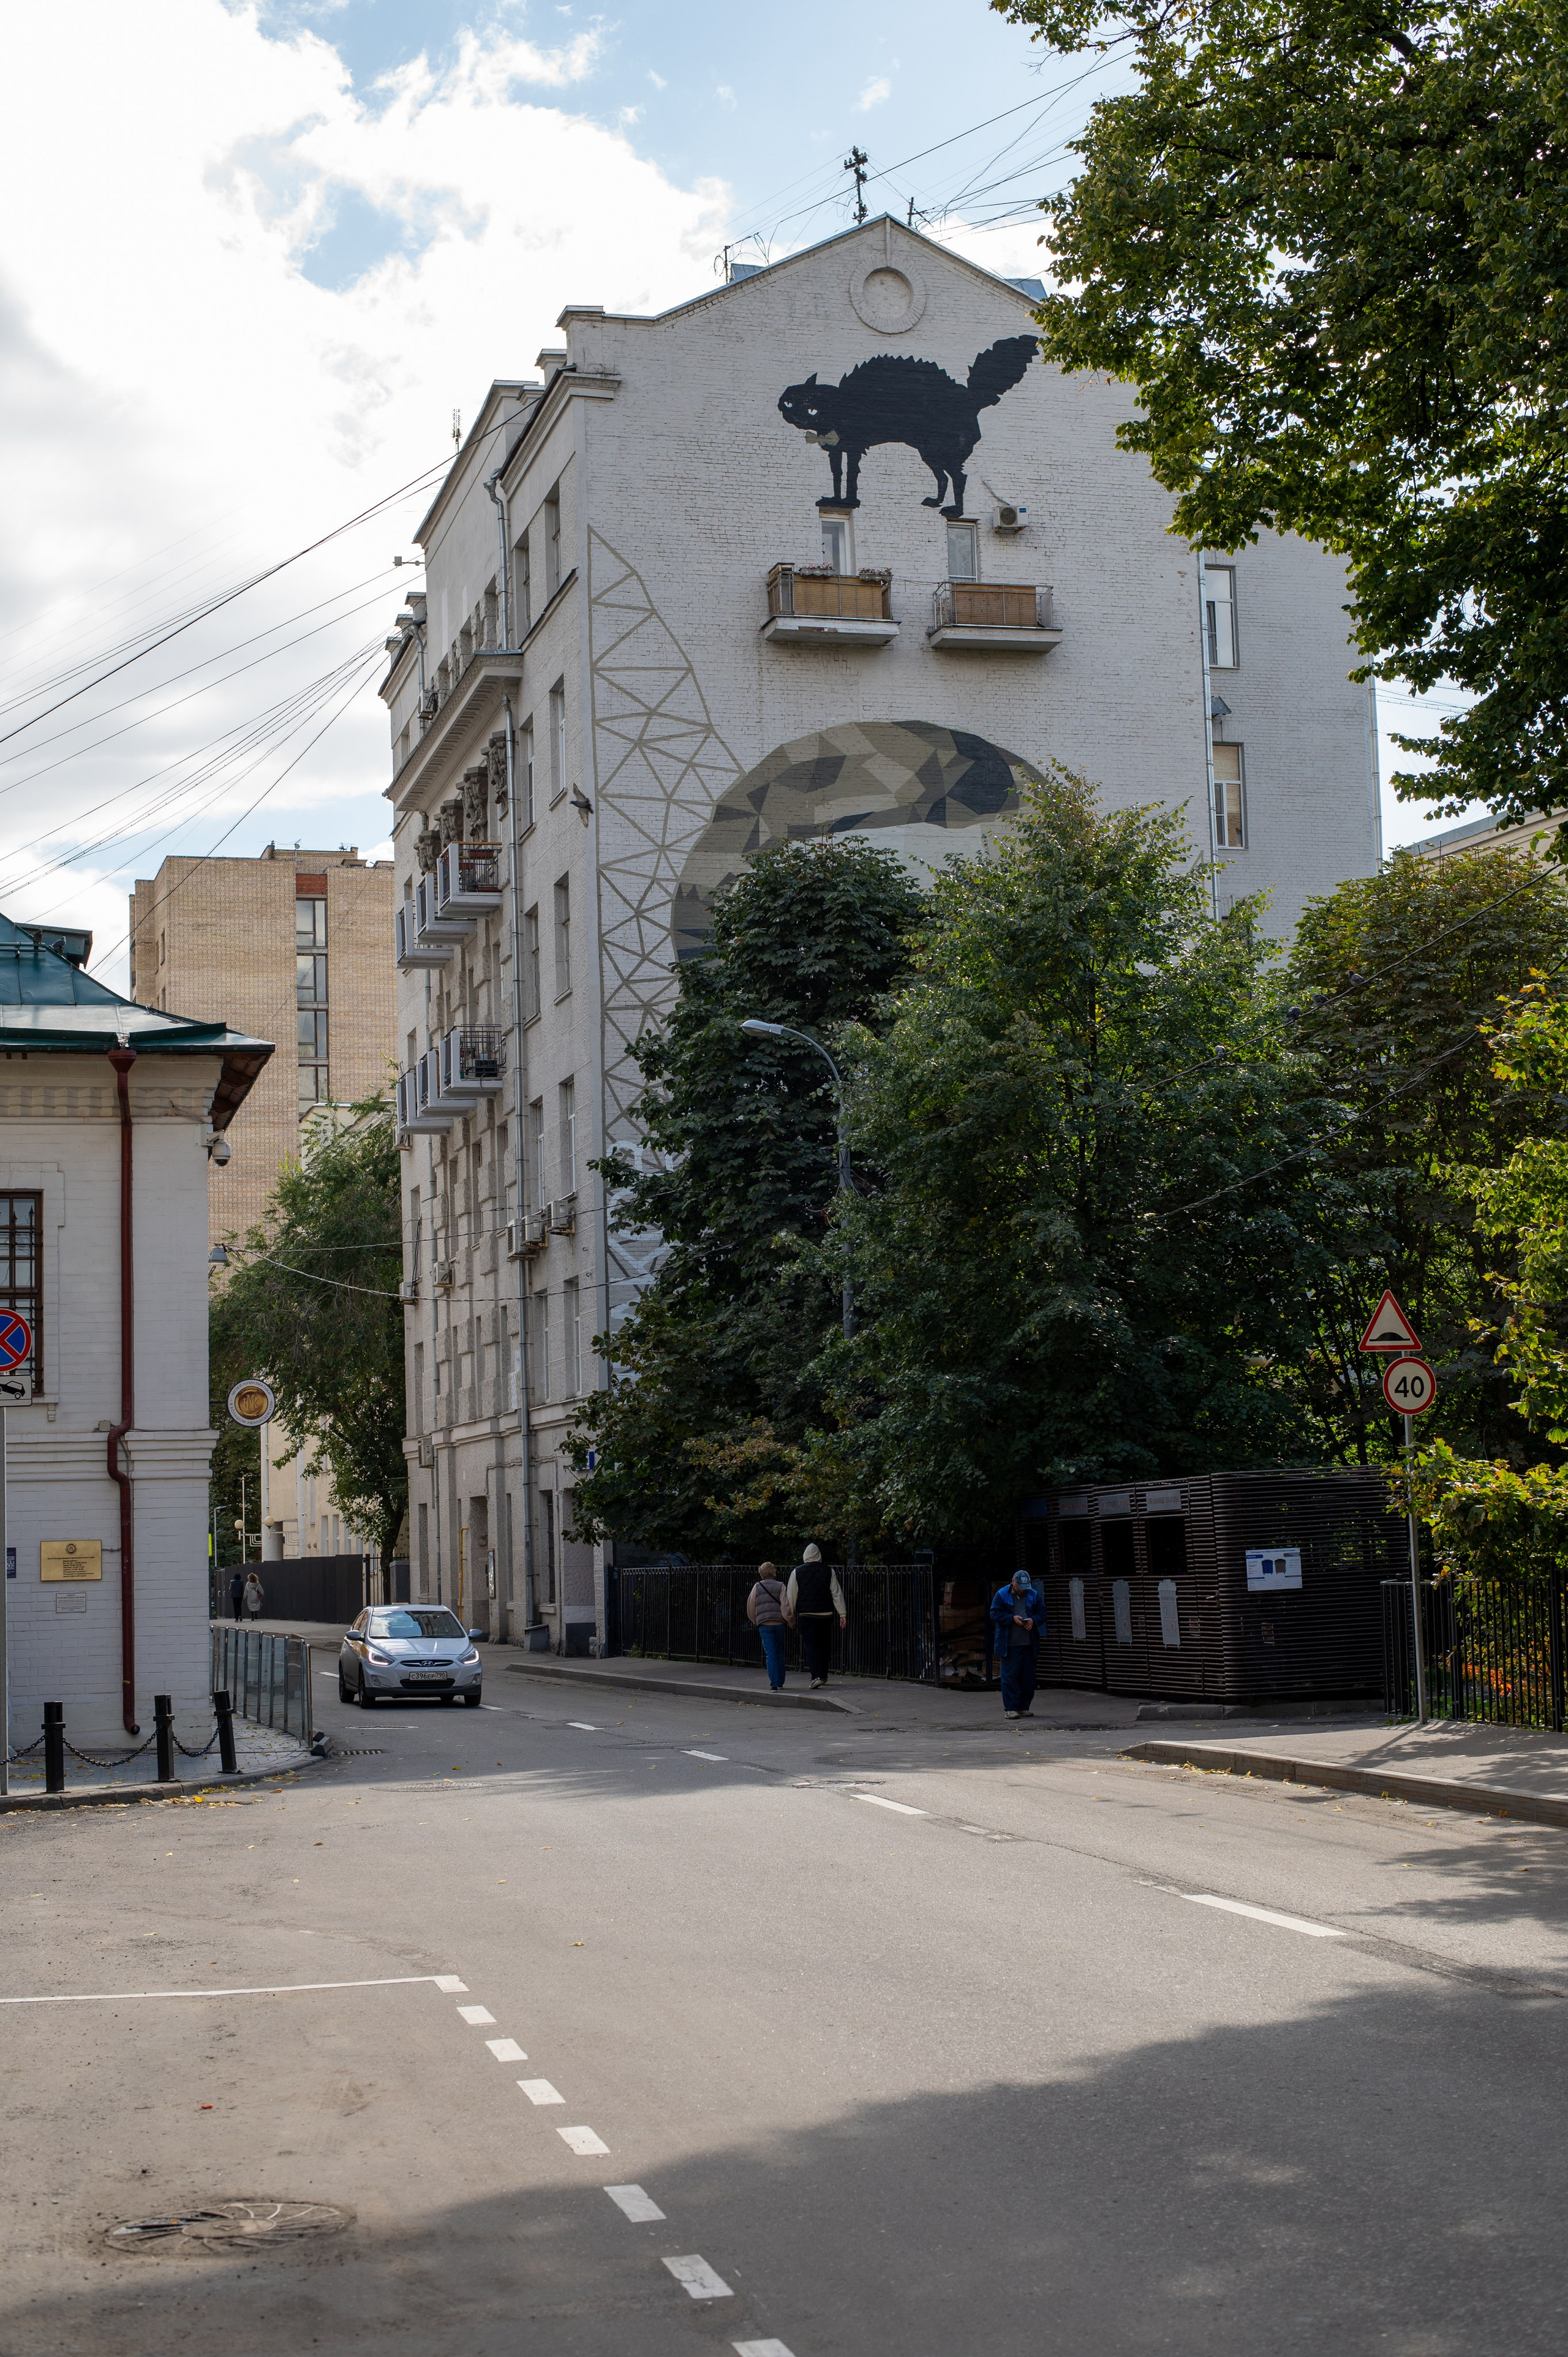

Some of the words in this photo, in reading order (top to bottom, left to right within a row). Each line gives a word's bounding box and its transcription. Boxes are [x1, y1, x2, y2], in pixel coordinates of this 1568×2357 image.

[232, 1384, 243, 1395] МУЗЕЙ
[243, 1381, 271, 1395] НУМИЗМАТИКИ
[1394, 1376, 1424, 1398] 40
[230, 1407, 246, 1423] БОЛЬШОМ
[246, 1401, 273, 1425] АФАНАСЬЕВСКОМ
